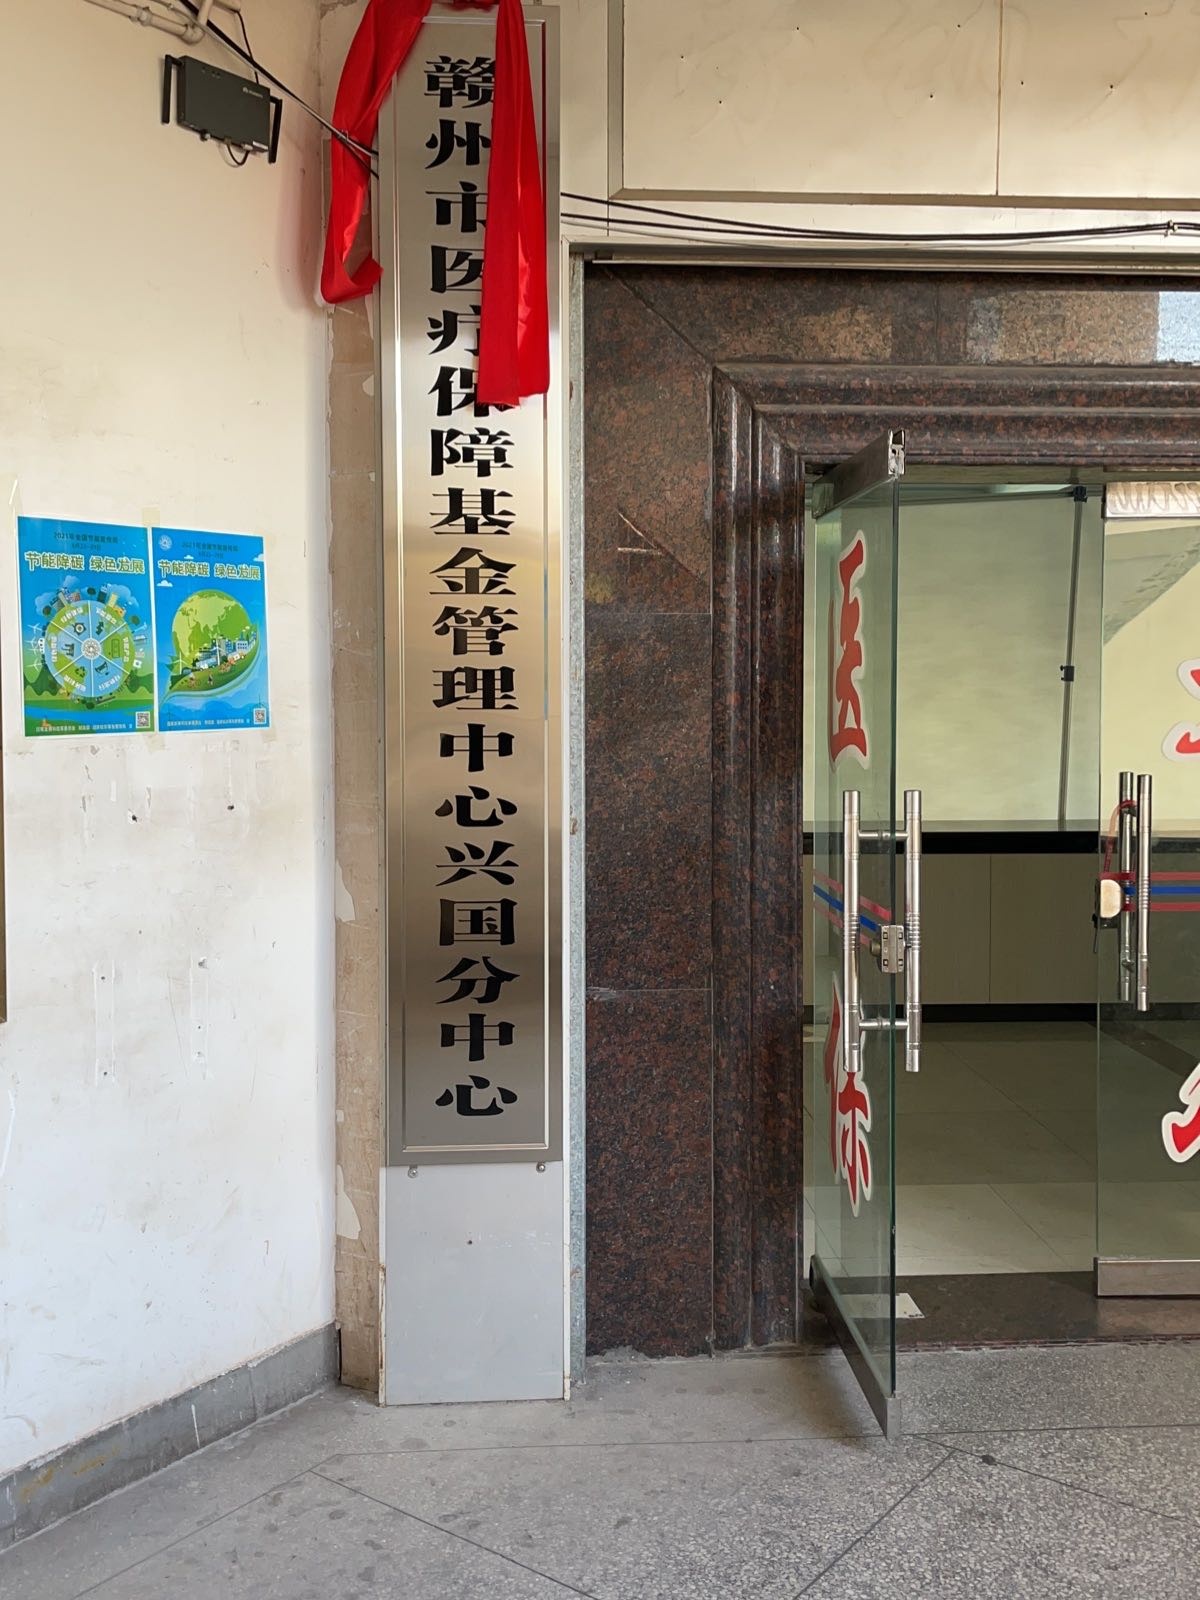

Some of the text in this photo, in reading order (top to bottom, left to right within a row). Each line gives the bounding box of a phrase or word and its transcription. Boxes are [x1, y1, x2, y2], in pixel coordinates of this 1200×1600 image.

[25, 551, 145, 575] 节能降碳 绿色发展
[159, 560, 261, 581] 节能降碳 绿色发展
